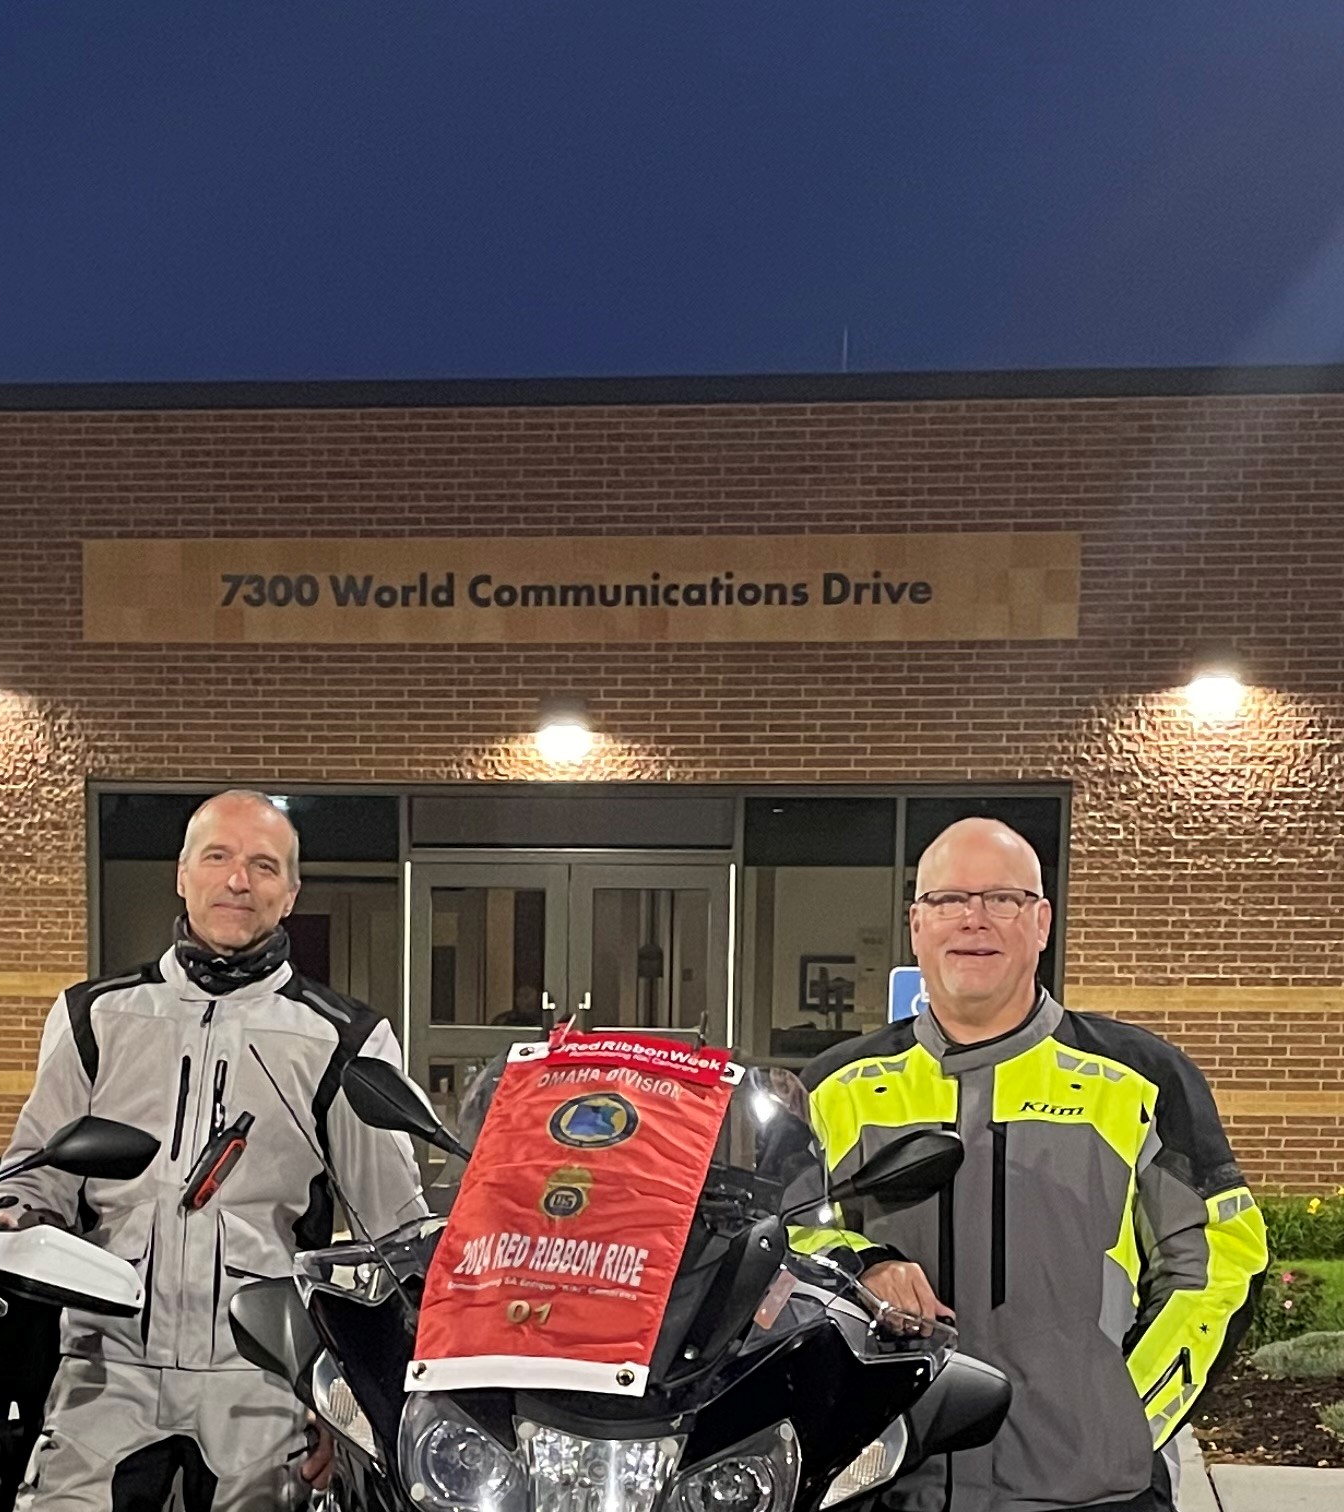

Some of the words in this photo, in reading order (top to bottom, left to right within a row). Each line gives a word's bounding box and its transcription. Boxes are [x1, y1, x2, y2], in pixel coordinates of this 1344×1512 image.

[220, 573, 320, 607] 7300
[329, 571, 455, 608] World
[467, 570, 809, 608] Communications
[822, 570, 933, 606] Drive
[537, 1067, 600, 1088] OMAHA
[606, 1067, 683, 1101] DIVISION
[453, 1233, 496, 1276] 2024
[492, 1232, 531, 1269] RED
[529, 1235, 603, 1278] RIBBON
[599, 1243, 649, 1287] RIDE
